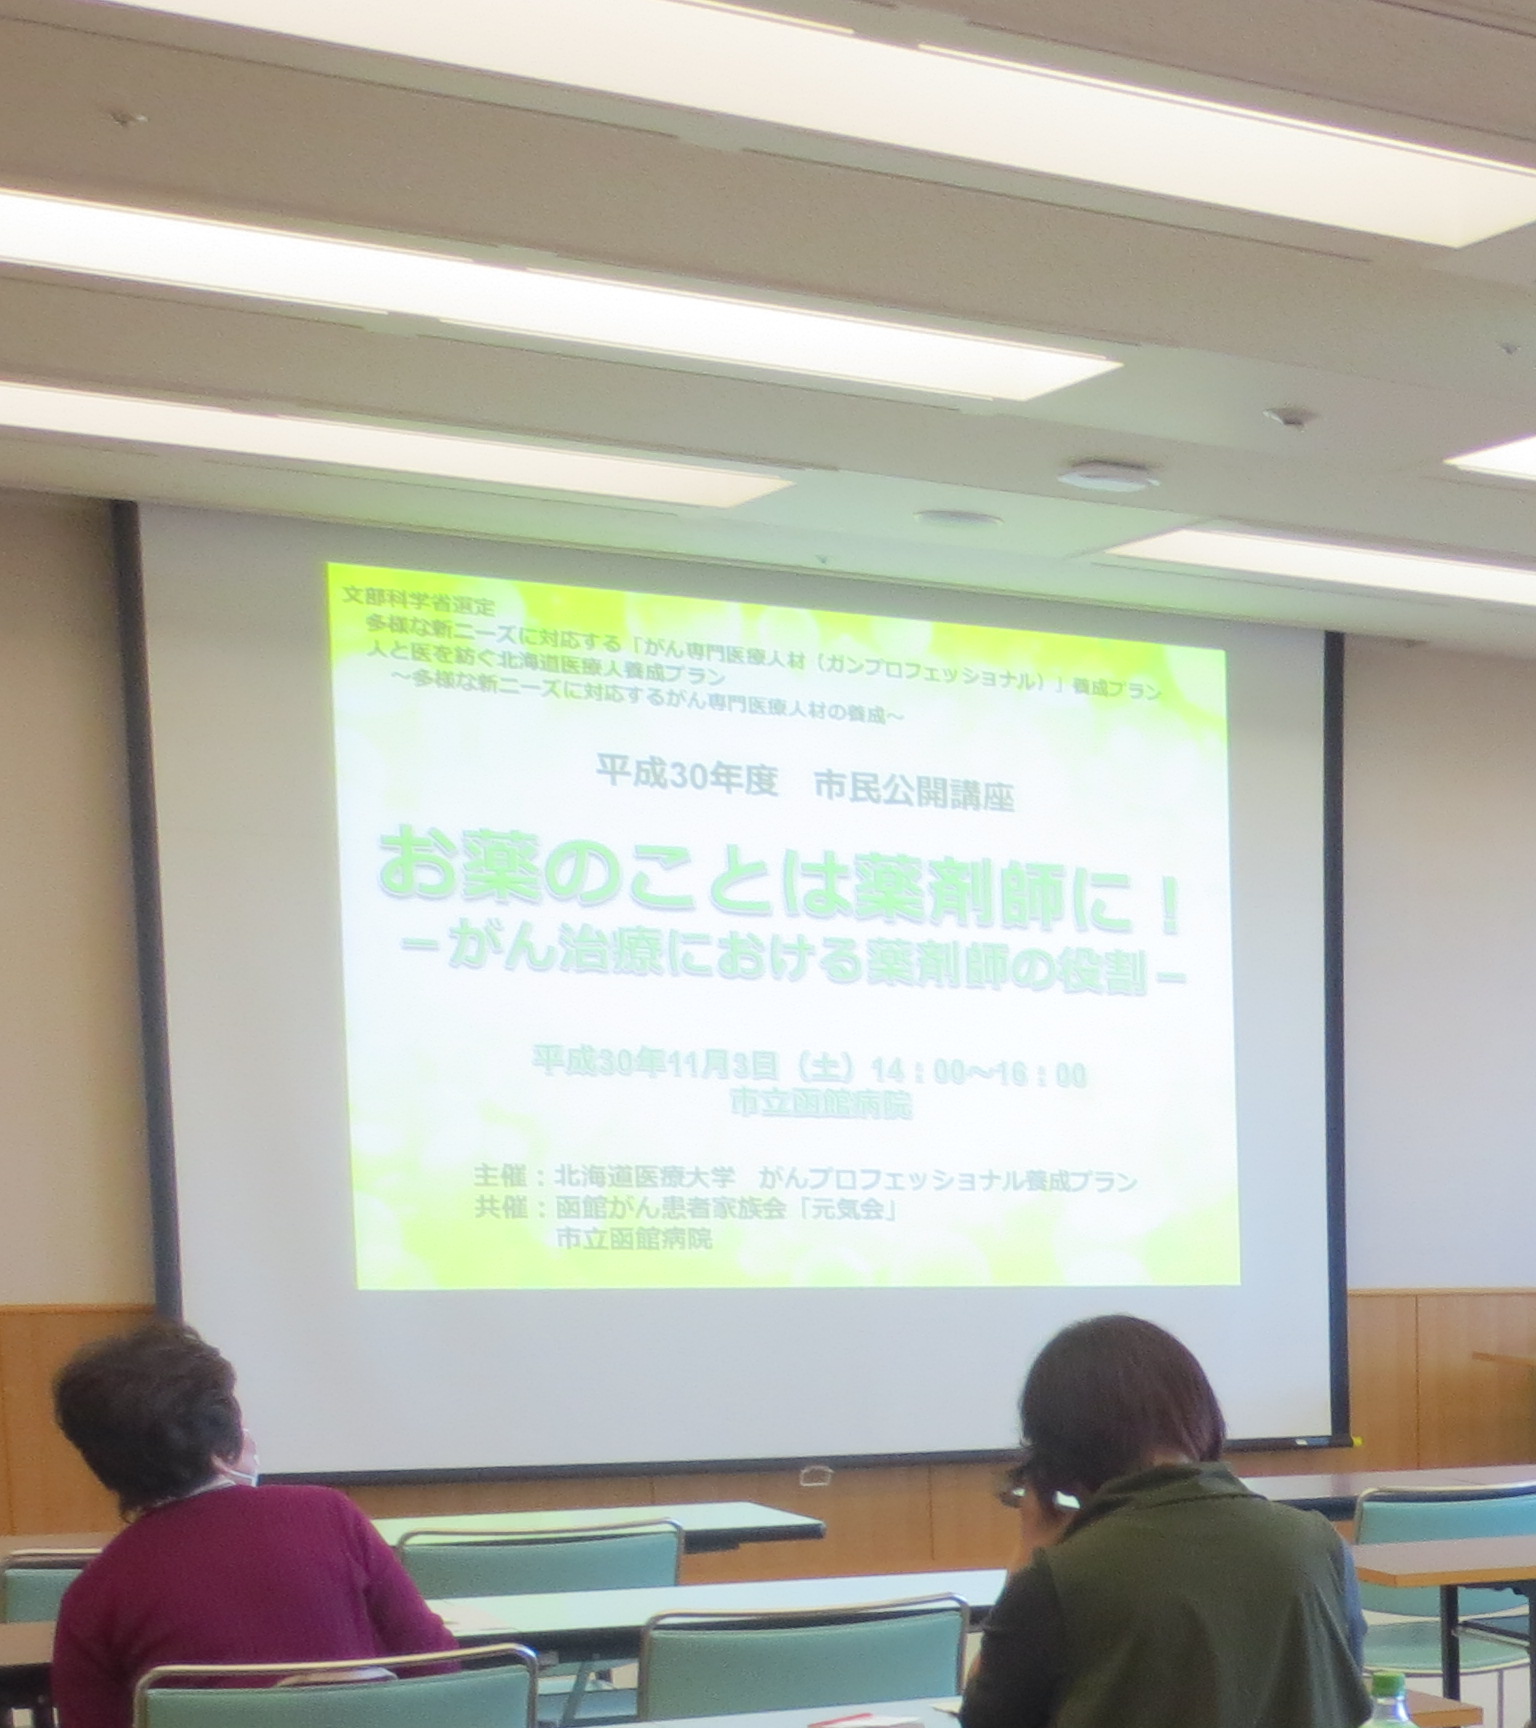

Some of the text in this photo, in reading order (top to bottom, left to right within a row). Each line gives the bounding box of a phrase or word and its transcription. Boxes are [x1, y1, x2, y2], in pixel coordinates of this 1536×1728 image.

[342, 585, 496, 618] 文部科学省選定
[595, 751, 1016, 813] 平成30年度 市民公開講座
[556, 1226, 714, 1251] 市立函館病院
